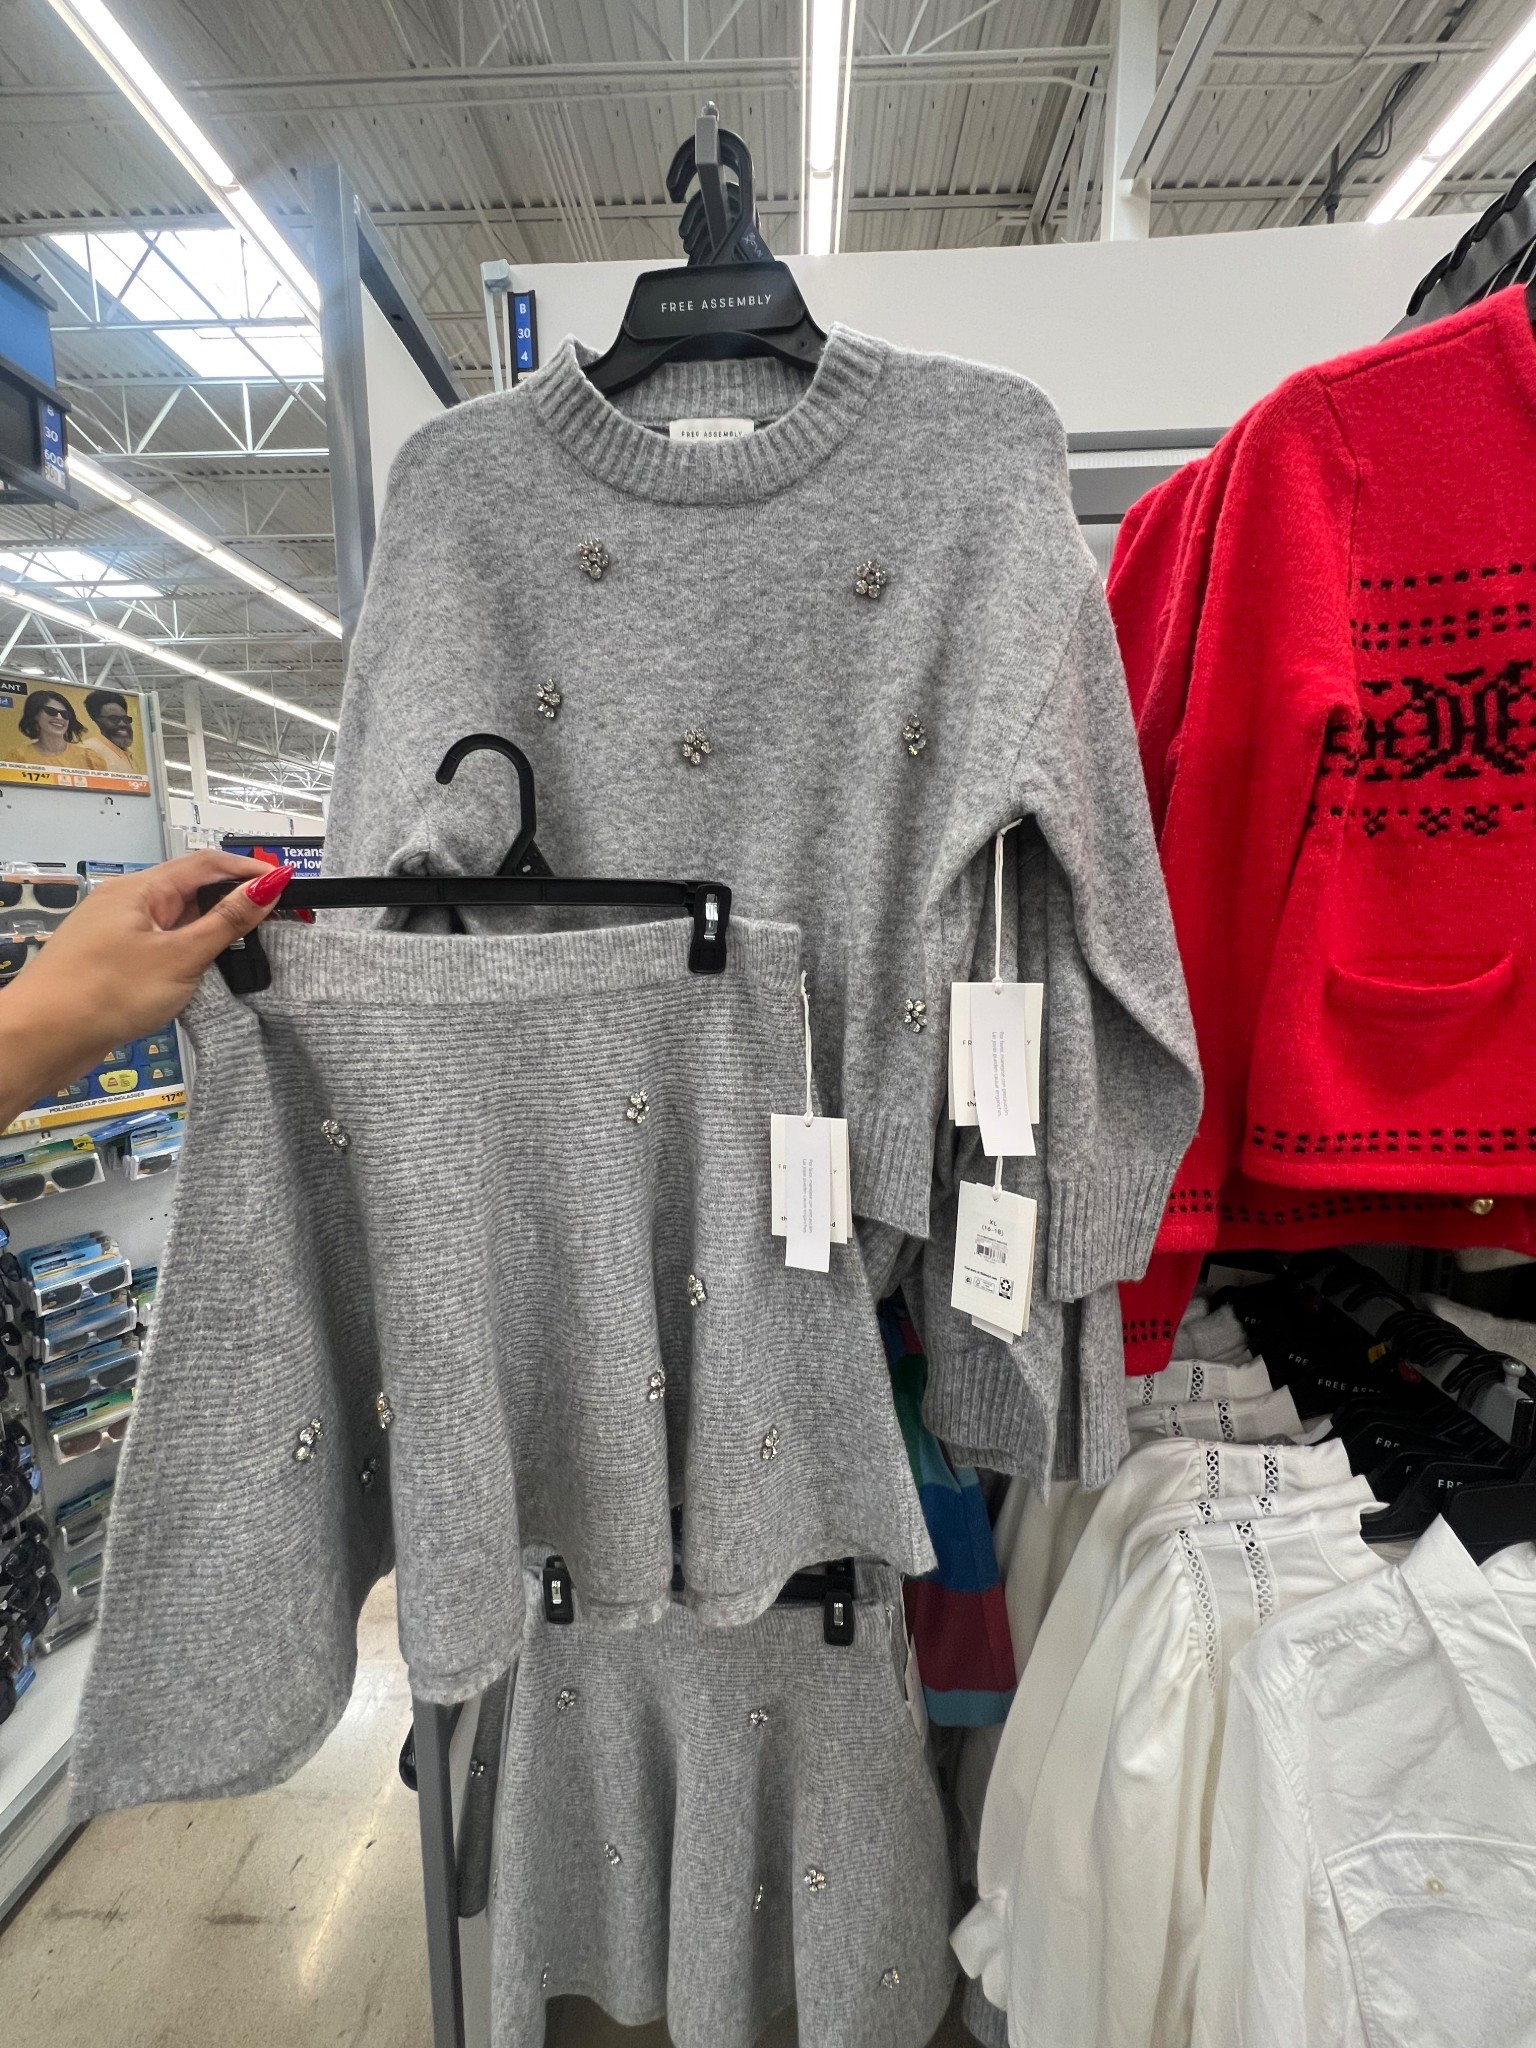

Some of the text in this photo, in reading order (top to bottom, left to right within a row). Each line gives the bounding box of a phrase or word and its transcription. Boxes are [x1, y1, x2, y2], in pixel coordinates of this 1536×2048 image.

[519, 303, 527, 314] B
[661, 293, 772, 313] FREE ASSEMBLY
[517, 328, 531, 339] 30
[520, 351, 529, 362] 4
[45, 426, 59, 442] 30
[44, 449, 64, 467] 600
[282, 847, 325, 857] Texans
[49, 1102, 84, 1113] POLARIZED
[1317, 1378, 1348, 1391] FREE
